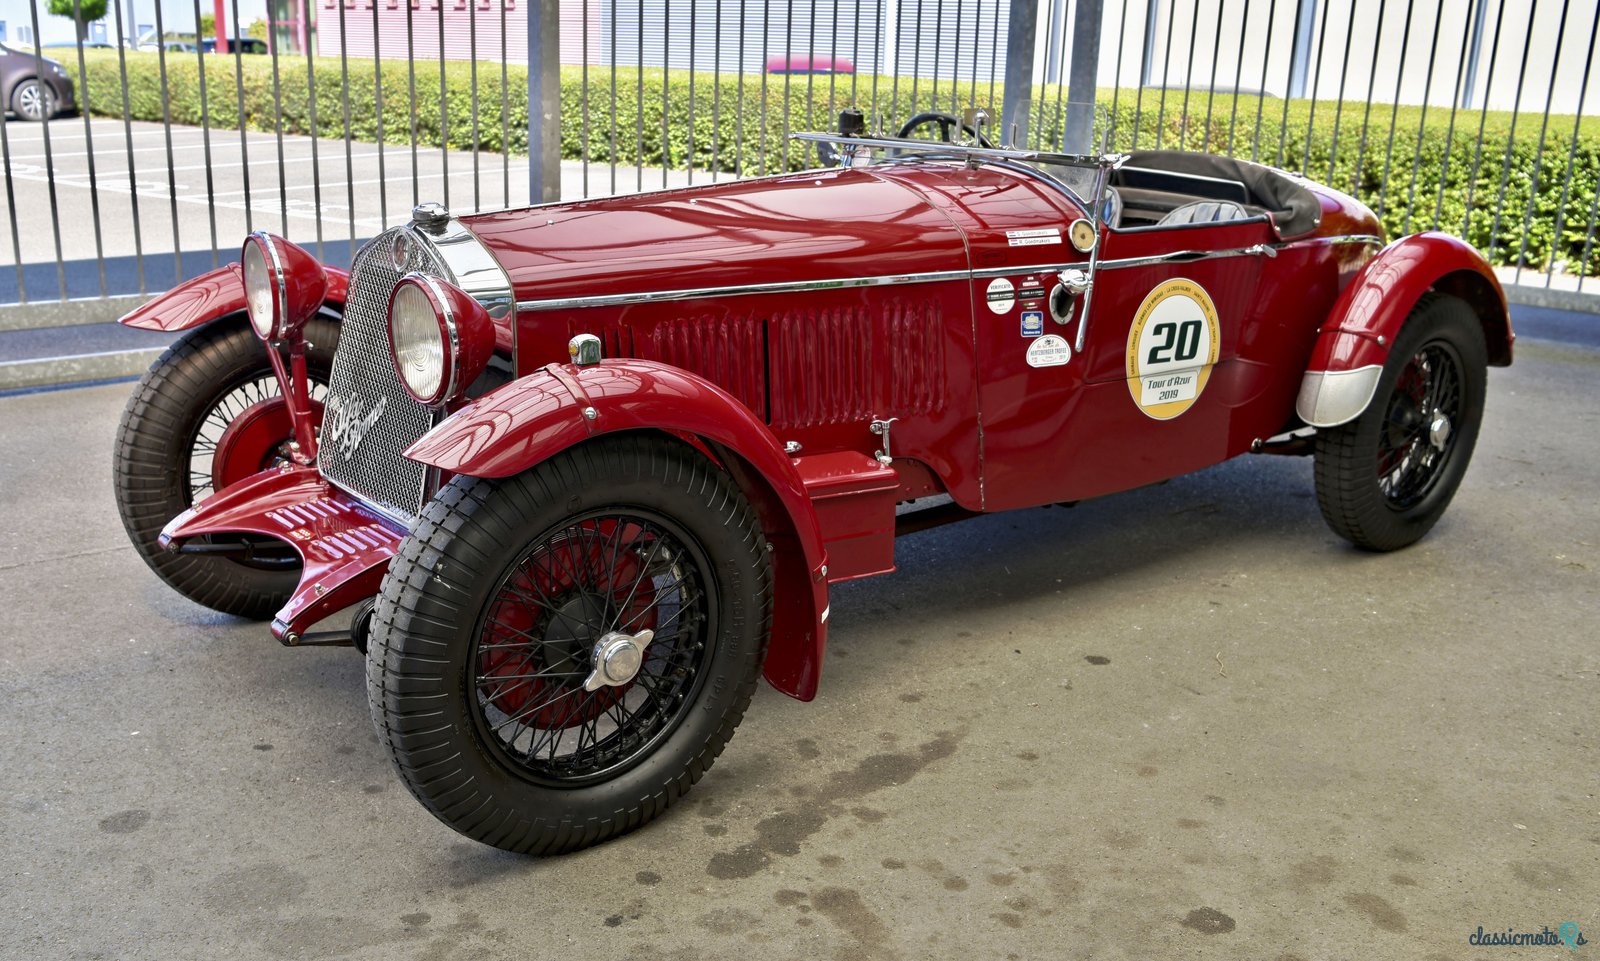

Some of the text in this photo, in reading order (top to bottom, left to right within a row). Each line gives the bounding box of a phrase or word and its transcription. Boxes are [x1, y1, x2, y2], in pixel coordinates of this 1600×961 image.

[1147, 320, 1202, 364] 20
[1148, 376, 1192, 389] Tour d'Azur
[1158, 389, 1179, 400] 2019
